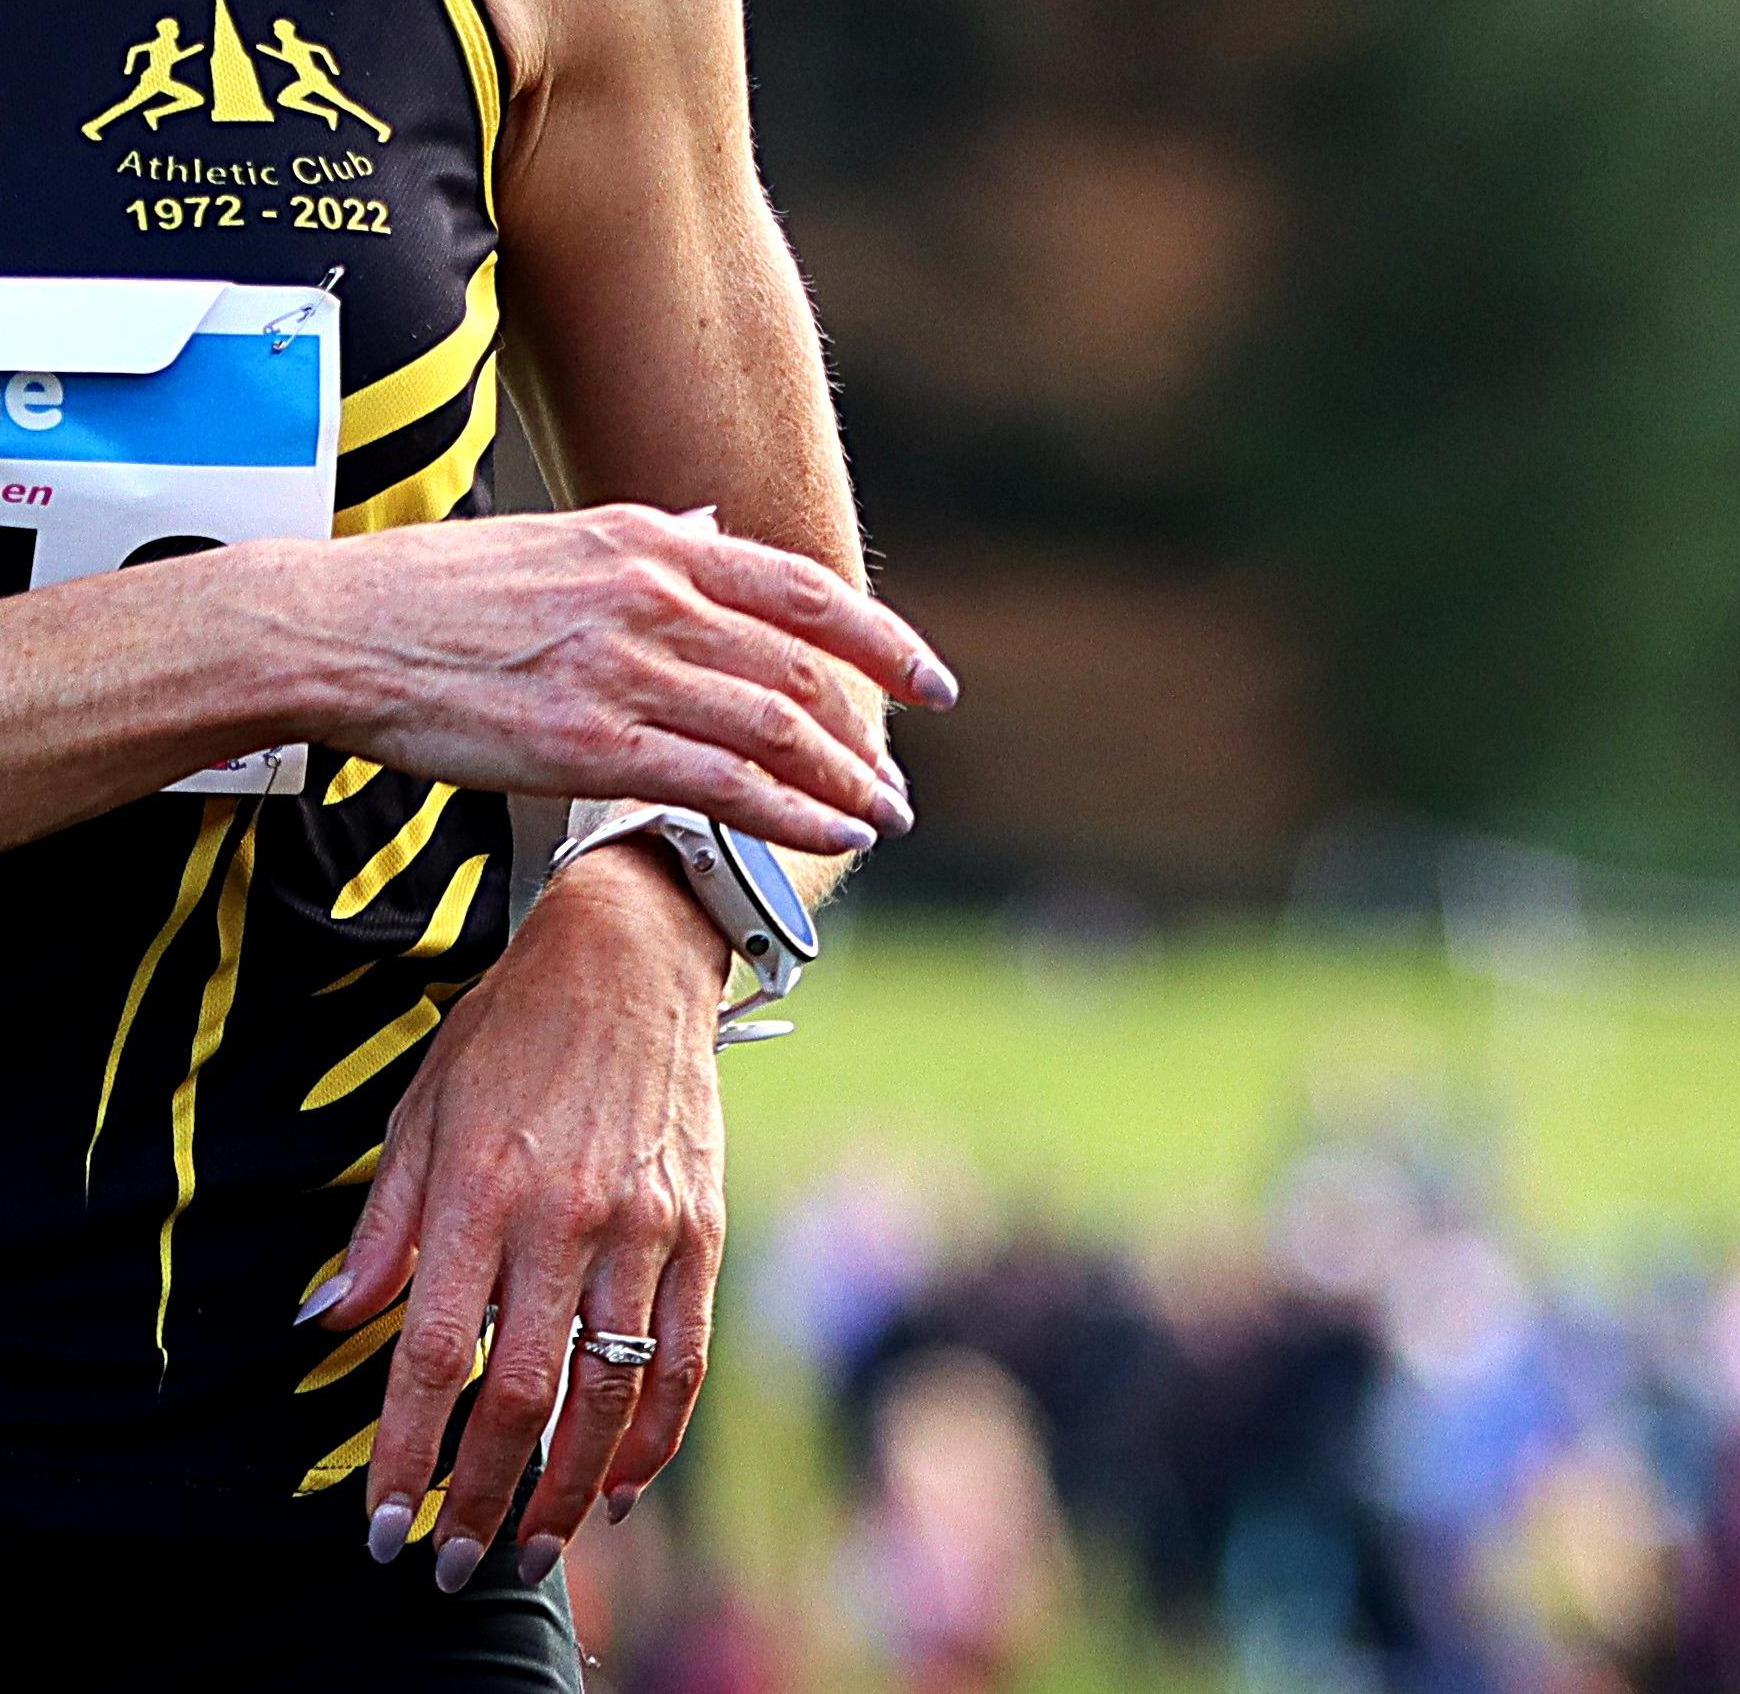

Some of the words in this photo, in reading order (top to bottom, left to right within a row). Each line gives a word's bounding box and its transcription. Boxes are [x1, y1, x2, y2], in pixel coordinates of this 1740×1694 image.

[117, 150, 279, 186] Athletic
[292, 152, 374, 184] Club
[126, 195, 245, 232] 1972
[290, 196, 392, 235] 2022
